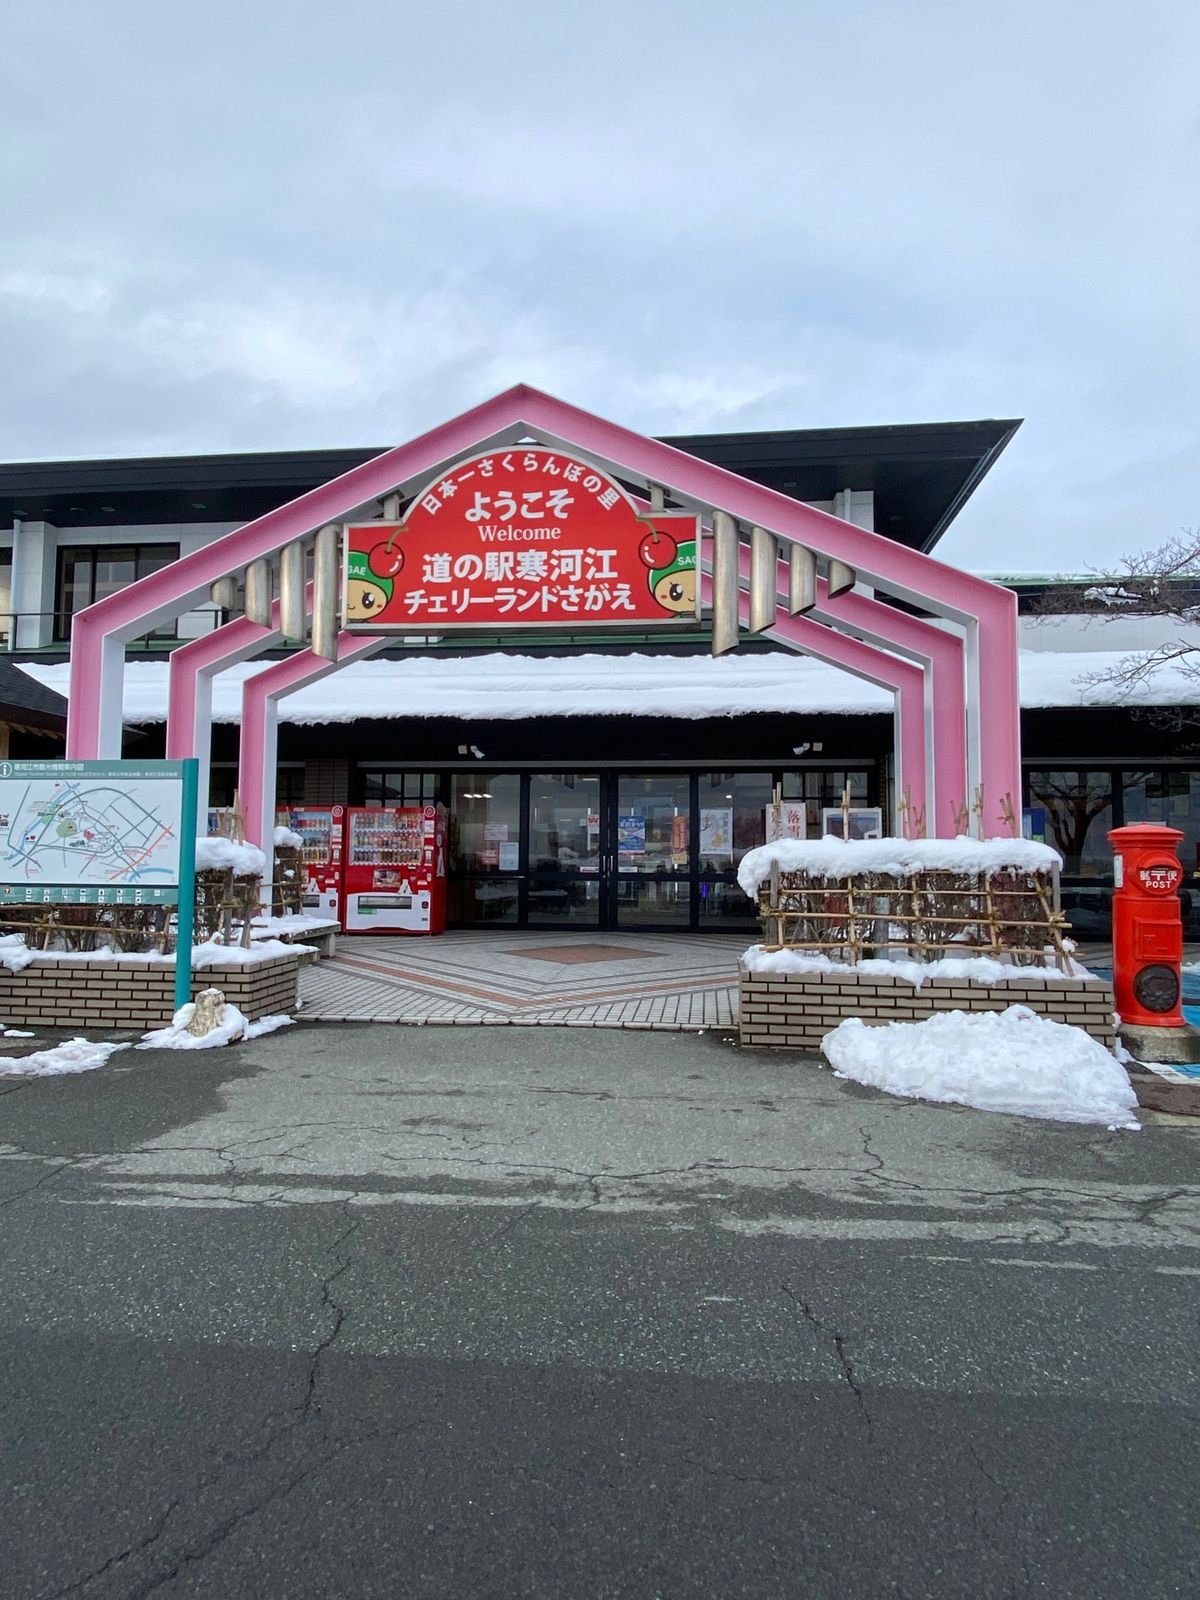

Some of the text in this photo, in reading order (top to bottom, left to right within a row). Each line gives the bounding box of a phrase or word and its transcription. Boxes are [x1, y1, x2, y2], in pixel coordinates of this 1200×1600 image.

[421, 453, 620, 515] 日本一さくらんぼの里
[464, 489, 575, 522] ようこそ
[477, 524, 561, 543] Welcome
[422, 547, 618, 583] 道の駅寒河江
[404, 583, 636, 615] チェリーランドさがえ
[1145, 881, 1172, 889] POST
